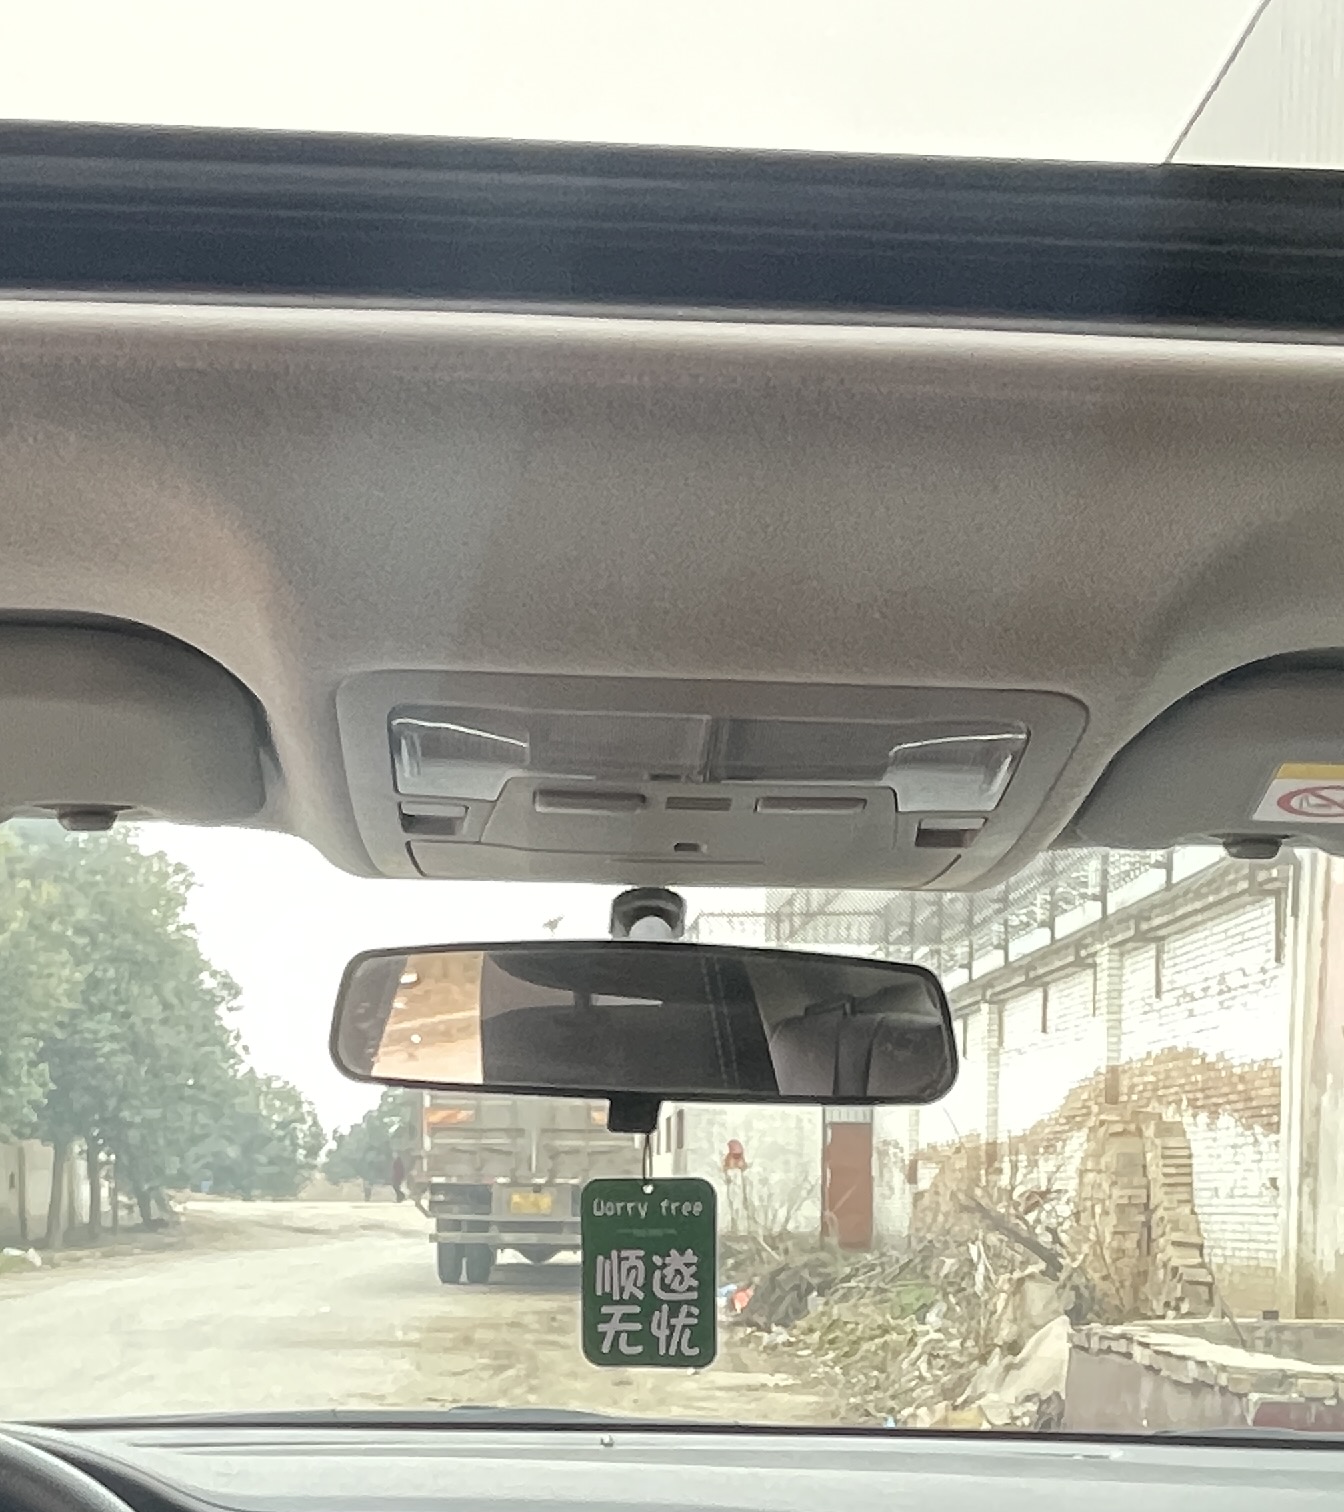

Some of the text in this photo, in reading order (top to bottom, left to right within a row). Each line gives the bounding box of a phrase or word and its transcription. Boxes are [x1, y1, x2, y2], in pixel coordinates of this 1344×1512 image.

[660, 1198, 703, 1217] free
[595, 1248, 699, 1301] 顺遂
[597, 1304, 700, 1356] 无忧
